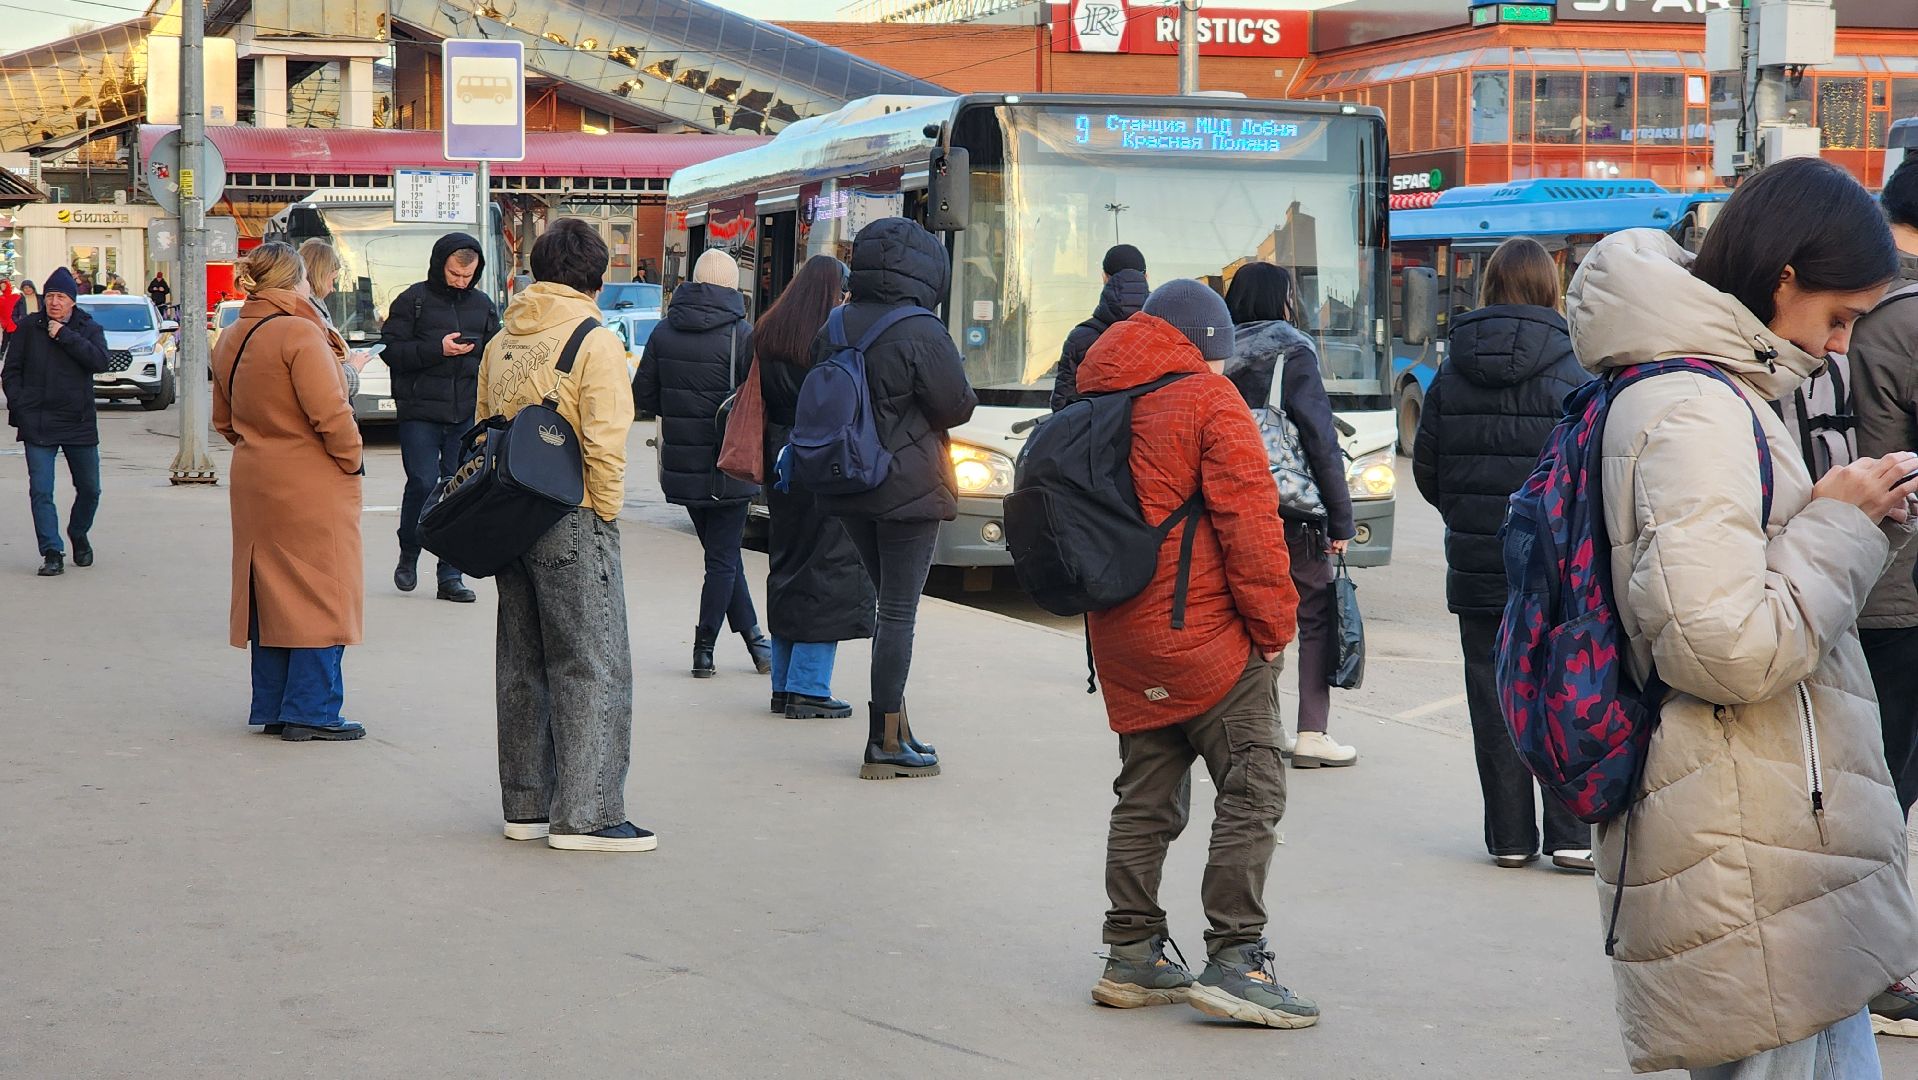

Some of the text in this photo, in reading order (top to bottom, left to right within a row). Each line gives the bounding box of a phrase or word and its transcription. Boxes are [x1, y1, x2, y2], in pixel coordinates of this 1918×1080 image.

[1075, 114, 1090, 144] 9
[1105, 115, 1187, 134] Станция
[1195, 117, 1233, 137] МЦД
[1122, 131, 1281, 152] Красная Поляна
[1392, 172, 1430, 191] SPAR
[73, 209, 129, 223] билайн
